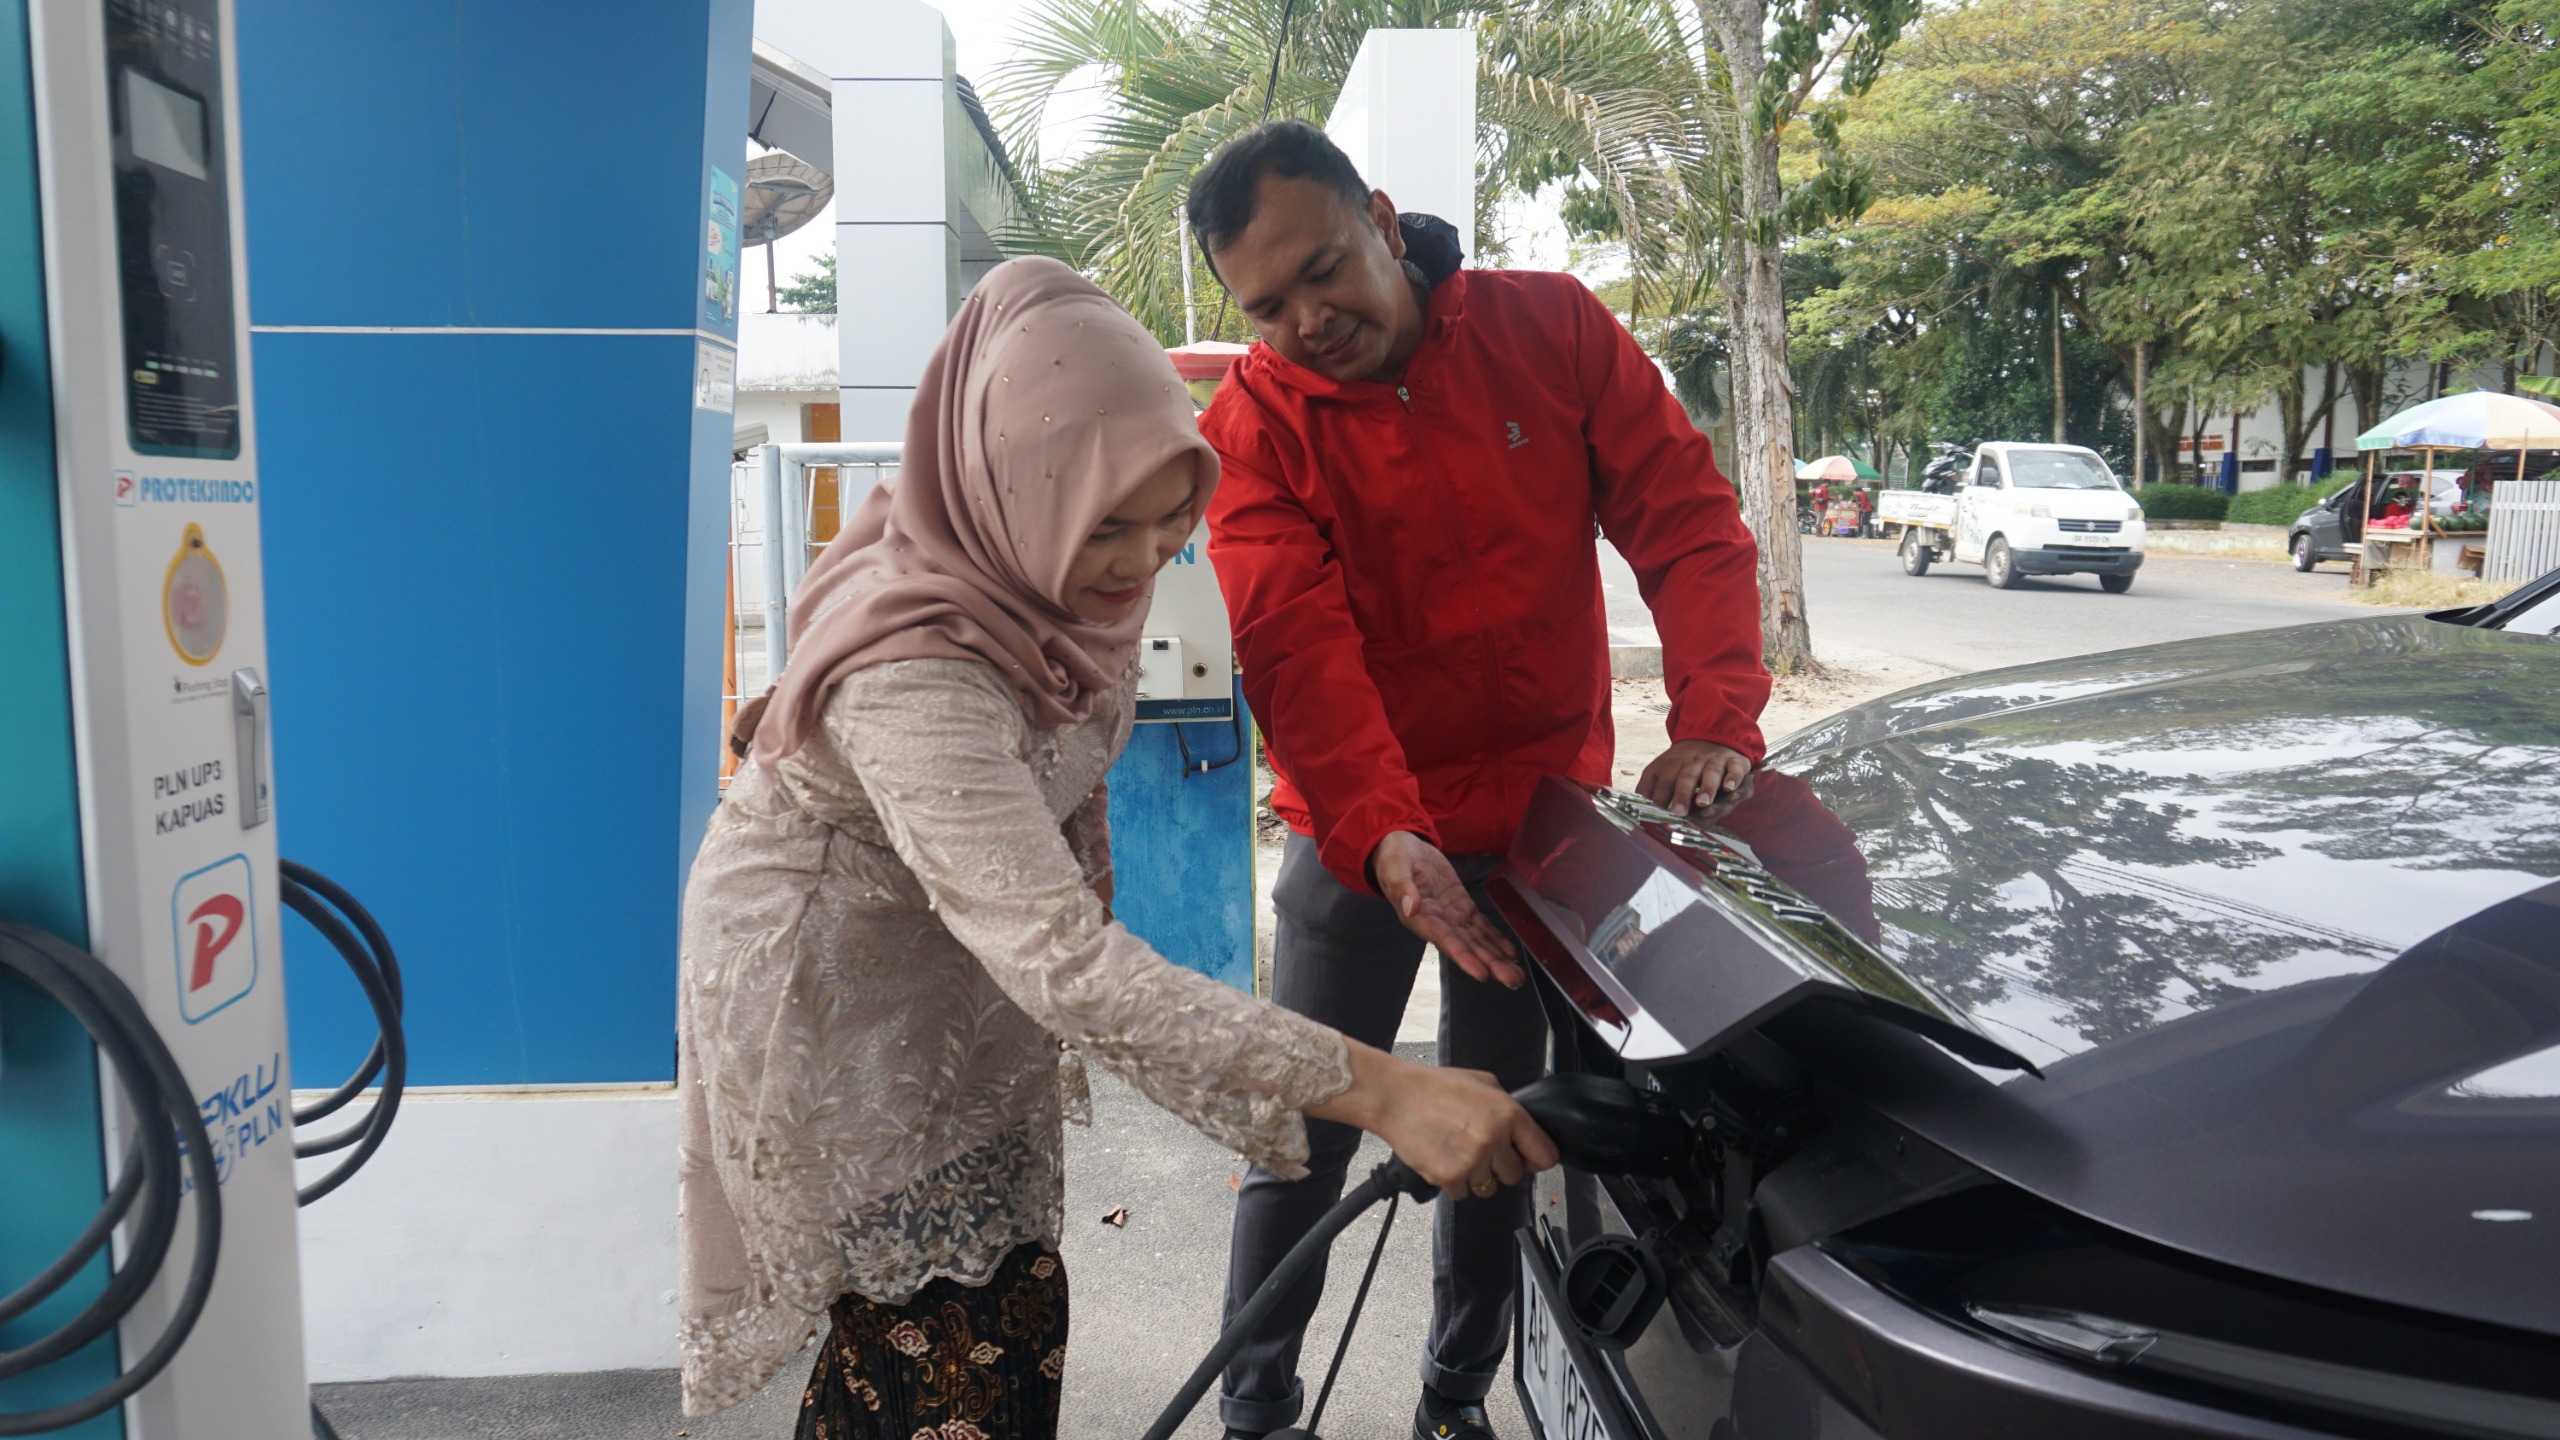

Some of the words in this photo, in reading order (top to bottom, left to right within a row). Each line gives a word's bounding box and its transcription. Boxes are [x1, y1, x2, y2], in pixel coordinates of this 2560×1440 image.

[1163, 704, 1225, 715] www.pln.co.id
[154, 769, 187, 799] PLN
[191, 760, 222, 787] UP3
[155, 793, 225, 836] KAPUAS
[237, 1098, 282, 1158] PLN
[1528, 1280, 1549, 1383] AB
